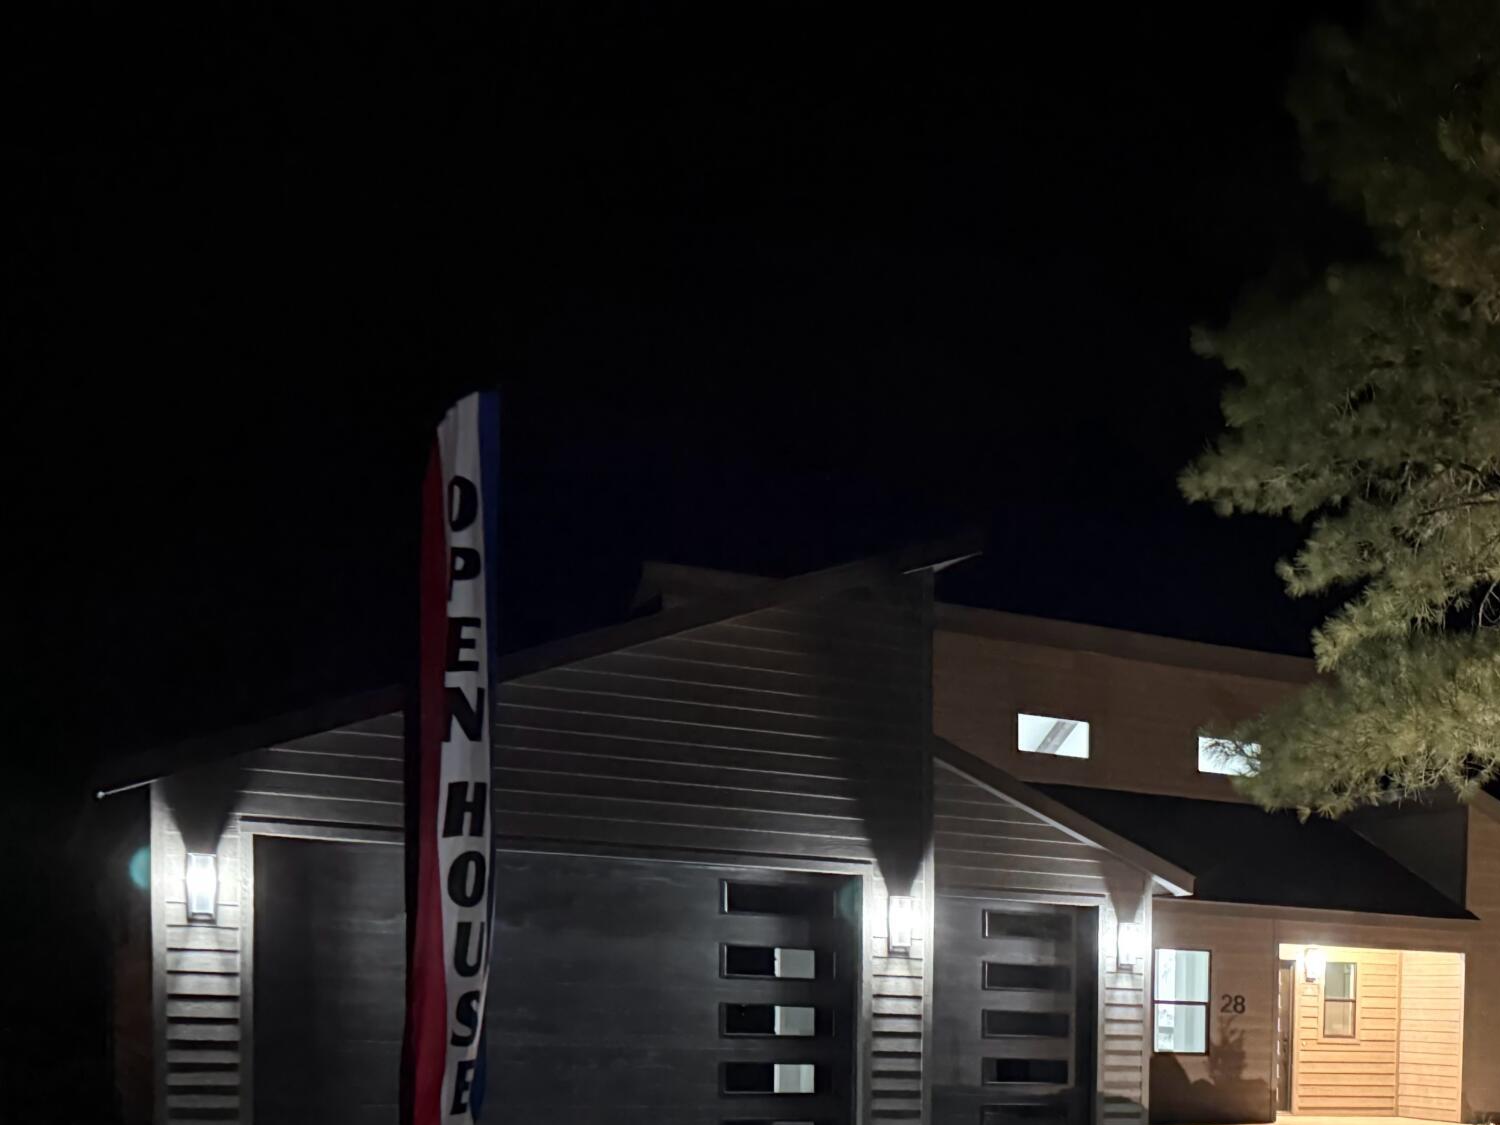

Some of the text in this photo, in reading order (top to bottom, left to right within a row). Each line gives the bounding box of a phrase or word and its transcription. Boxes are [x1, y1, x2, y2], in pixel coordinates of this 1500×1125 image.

[441, 475, 488, 1115] OPEN HOUSE
[1220, 994, 1246, 1015] 28
